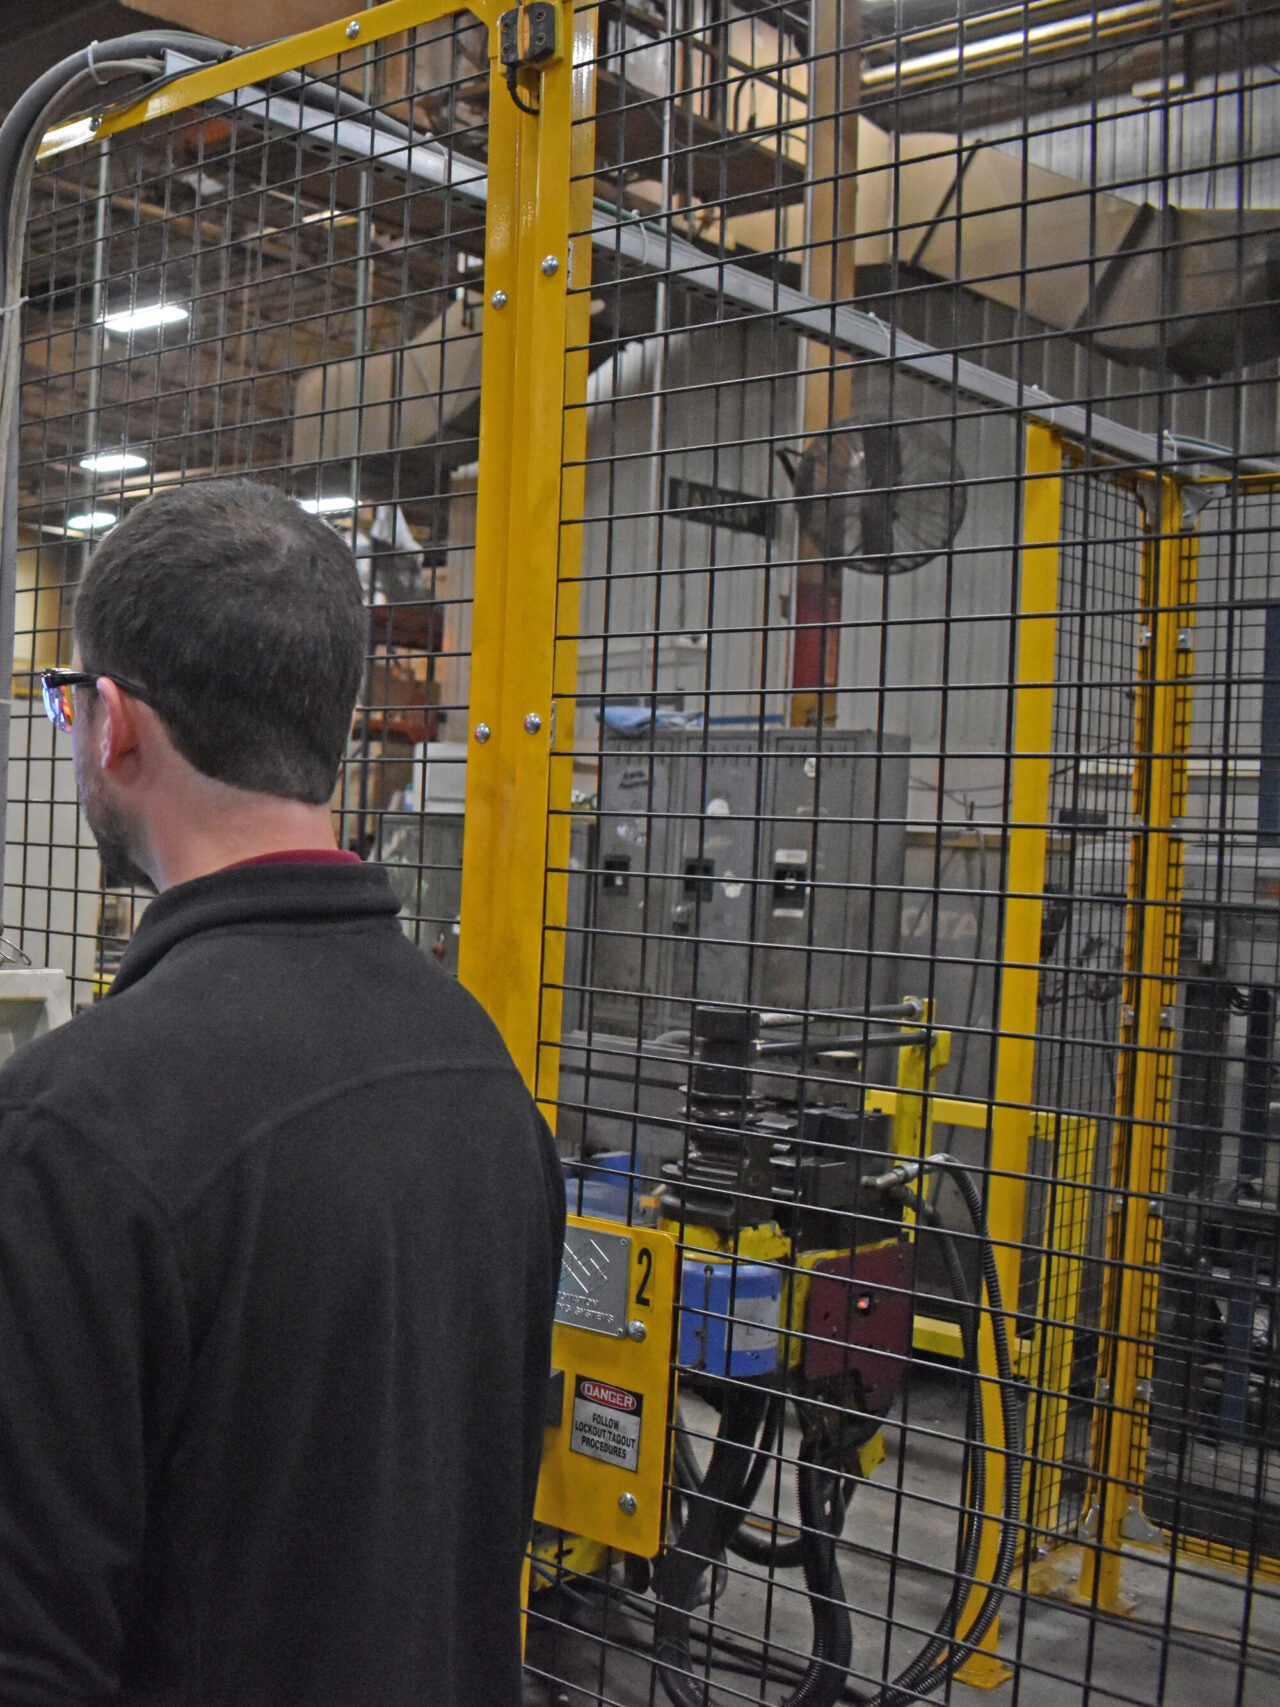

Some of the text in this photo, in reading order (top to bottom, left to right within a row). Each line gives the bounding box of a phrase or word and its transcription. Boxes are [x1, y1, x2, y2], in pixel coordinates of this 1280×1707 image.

[635, 1247, 653, 1307] 2
[574, 1306, 615, 1323] SYSTEMS
[584, 1383, 633, 1408] DANGER
[592, 1412, 620, 1431] FOLLOW
[581, 1435, 627, 1459] PROCEDURES
